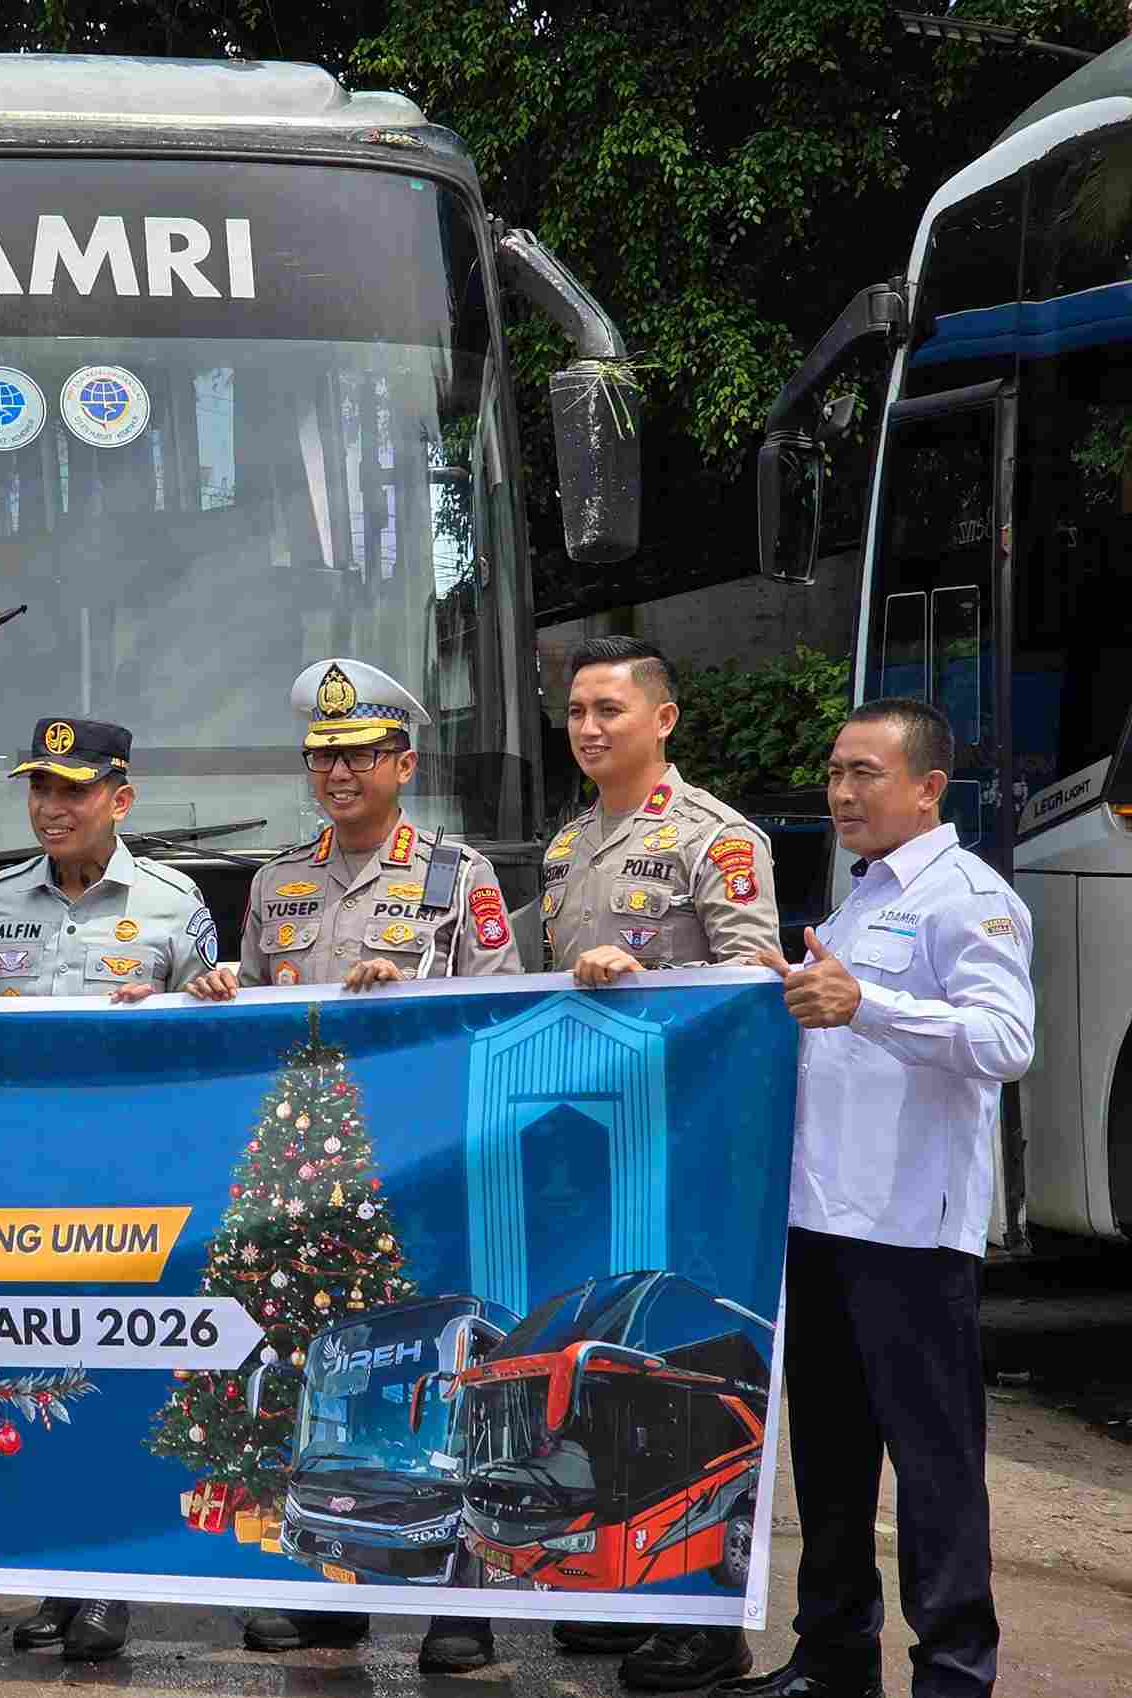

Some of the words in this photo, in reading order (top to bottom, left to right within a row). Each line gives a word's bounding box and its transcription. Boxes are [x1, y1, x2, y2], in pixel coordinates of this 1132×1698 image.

[621, 859, 676, 881] POLRI
[267, 902, 318, 917] YUSEP
[886, 911, 919, 925] DAMRI
[51, 1223, 158, 1254] UMUM
[96, 1308, 219, 1348] 2026
[325, 1339, 422, 1377] JIREH
